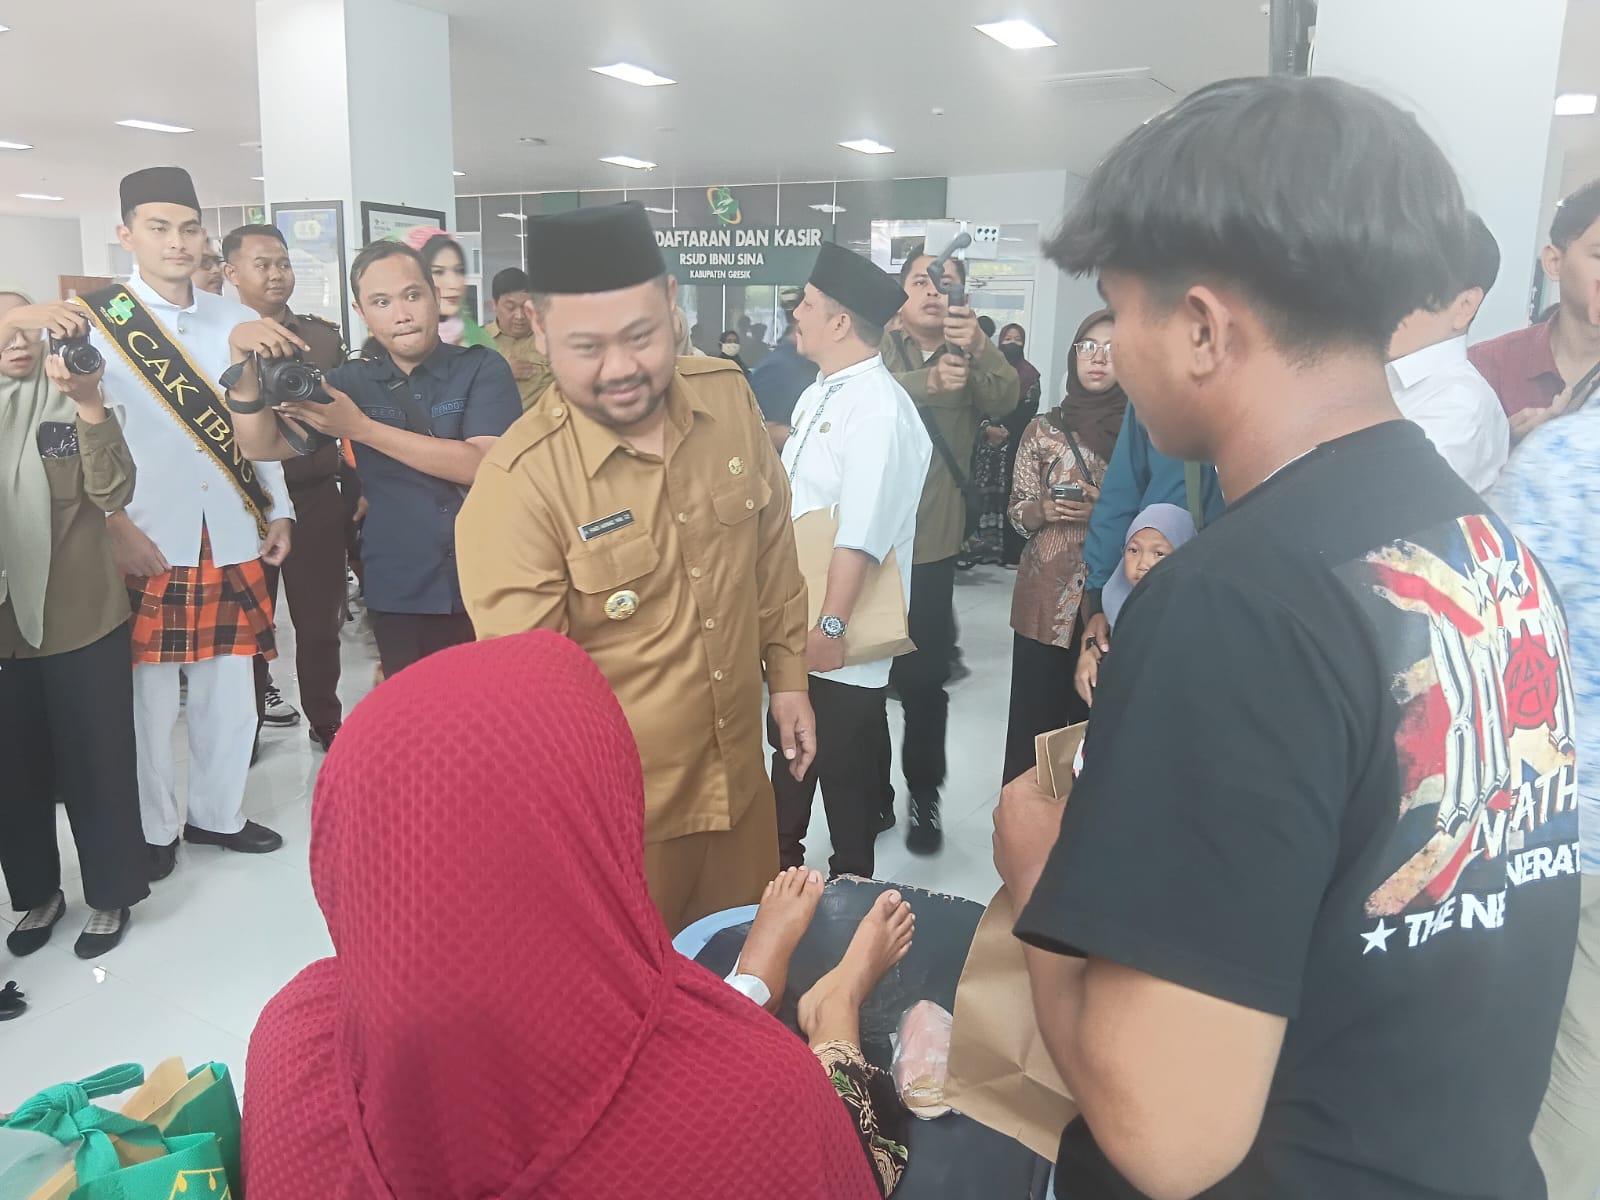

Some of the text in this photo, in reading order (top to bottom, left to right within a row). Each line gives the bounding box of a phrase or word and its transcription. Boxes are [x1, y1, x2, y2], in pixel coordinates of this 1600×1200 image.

[735, 229, 769, 247] DAN
[774, 228, 822, 247] KASIR
[679, 253, 764, 265] RSUD IBNU SINA
[689, 270, 751, 279] KABUPATEN GRESIK
[127, 330, 200, 406] CAK
[1405, 896, 1456, 947] THE
